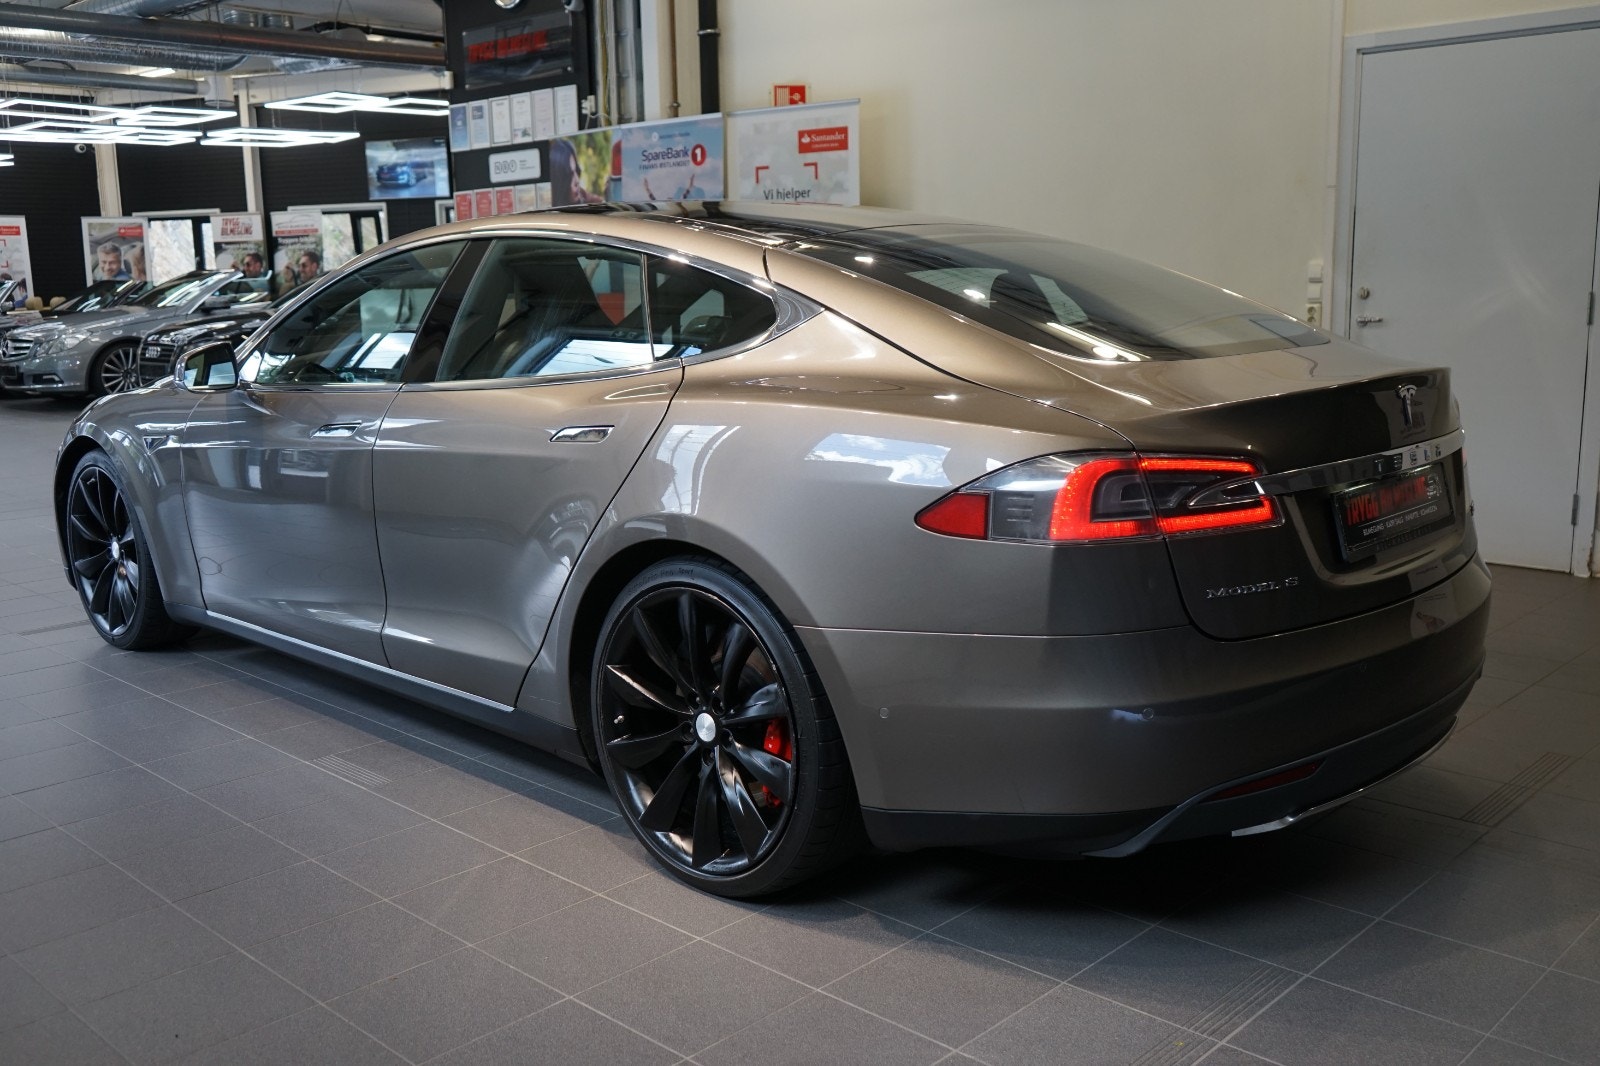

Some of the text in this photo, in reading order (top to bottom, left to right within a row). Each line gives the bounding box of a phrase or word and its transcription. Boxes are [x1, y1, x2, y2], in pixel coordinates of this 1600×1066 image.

[811, 131, 845, 143] Santander
[641, 146, 689, 162] SpareBank
[763, 187, 811, 201] Vi hjelper
[1285, 576, 1298, 587] S
